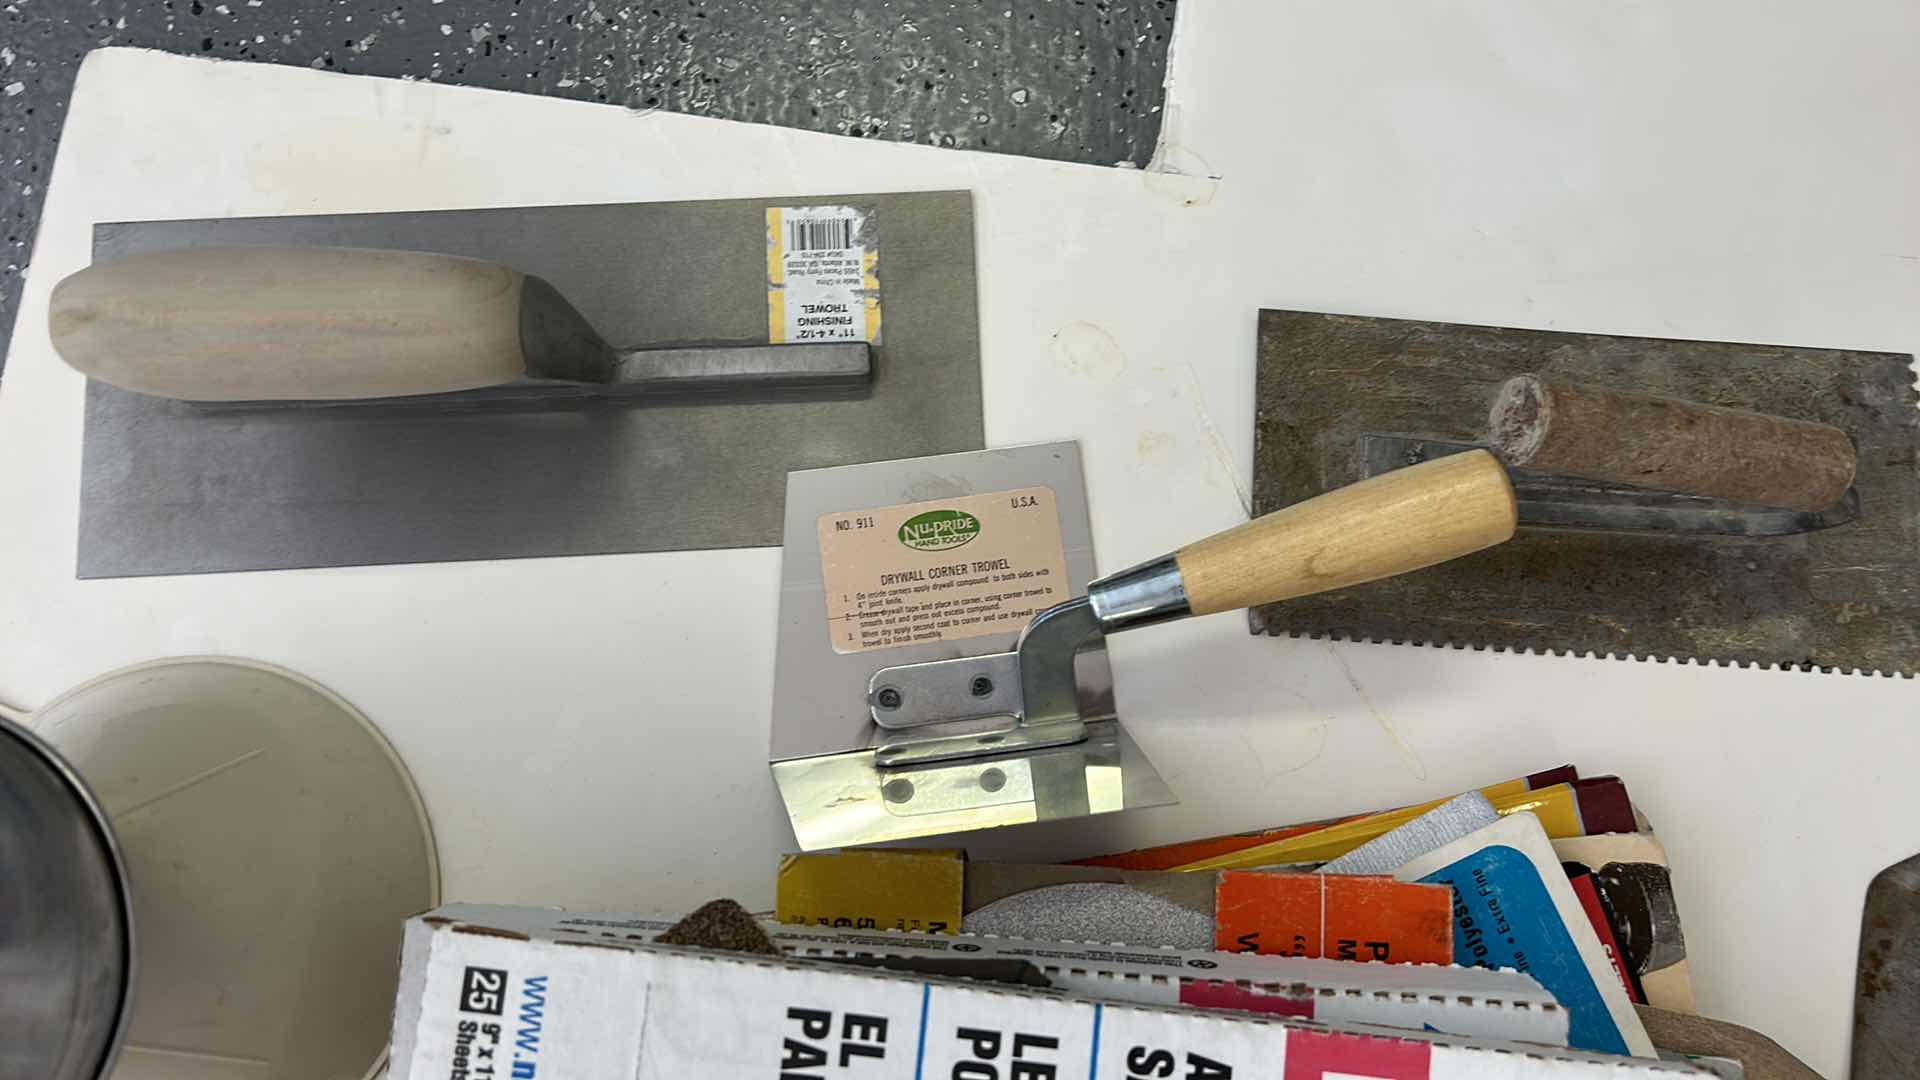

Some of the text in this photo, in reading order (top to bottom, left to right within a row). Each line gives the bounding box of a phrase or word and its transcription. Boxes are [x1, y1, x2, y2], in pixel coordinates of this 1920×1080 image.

[797, 316, 852, 326] FINISHING
[800, 304, 848, 314] TROWEL
[796, 329, 825, 338] 4-1/2"
[840, 329, 855, 337] 11"
[836, 516, 875, 532] NO. 911
[914, 538, 940, 548] HAND
[880, 558, 1010, 586] DRYWALL CORNER TROWEL
[888, 587, 912, 596] corners
[913, 584, 930, 593] apply
[932, 580, 954, 590] drywall
[956, 576, 988, 587] compound
[1001, 572, 1016, 581] both
[1036, 568, 1049, 576] with
[860, 620, 882, 628] smooth
[912, 614, 929, 622] press
[966, 603, 1001, 614] compound.
[881, 607, 903, 617] drywall
[921, 602, 932, 610] and
[934, 601, 951, 610] place
[985, 594, 1001, 602] using
[1024, 588, 1044, 596] trowel
[880, 628, 892, 636] dry
[894, 626, 911, 634] apply
[912, 622, 935, 631] second
[936, 620, 951, 628] coat
[962, 616, 981, 624] corner
[984, 614, 995, 622] and
[998, 612, 1008, 620] use
[1010, 608, 1033, 618] drywall
[1472, 868, 1493, 897] Fine
[1488, 899, 1512, 936] Extra
[468, 970, 501, 1010] 25
[482, 1023, 502, 1045] 9"
[511, 975, 549, 1080] www.n
[838, 1012, 889, 1068] EL
[452, 1020, 478, 1080] Sheets
[477, 1046, 494, 1061] x
[780, 1007, 833, 1080] PA
